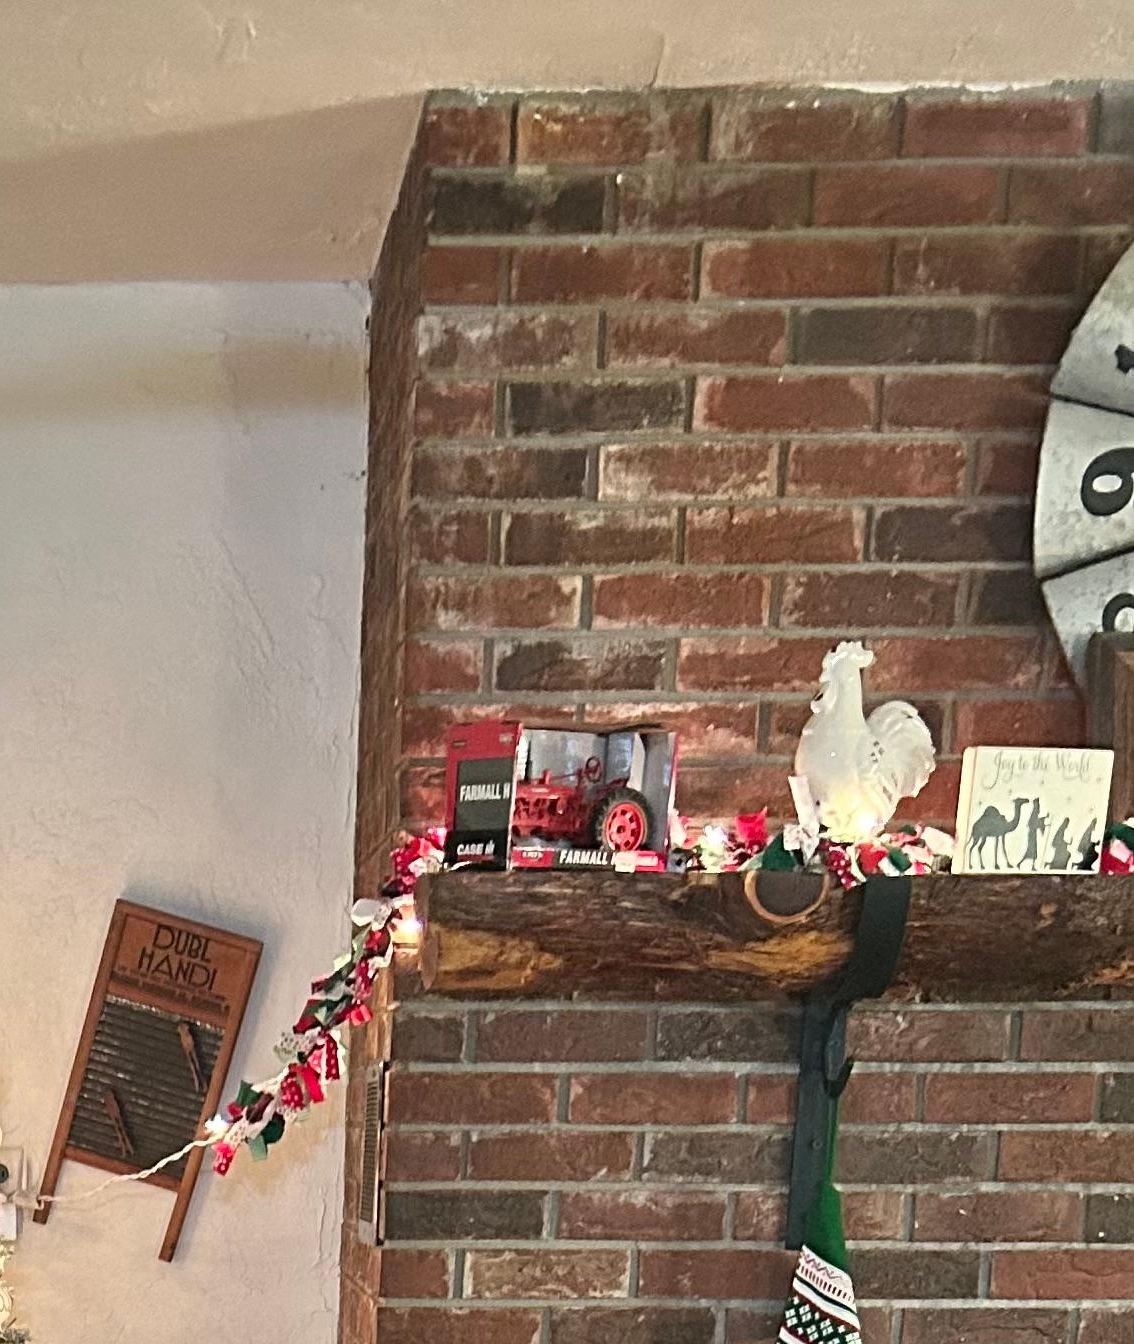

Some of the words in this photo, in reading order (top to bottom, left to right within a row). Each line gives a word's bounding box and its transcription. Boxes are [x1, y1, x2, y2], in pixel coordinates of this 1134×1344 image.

[982, 751, 1015, 790] Joy
[1017, 755, 1028, 771] to
[1031, 751, 1049, 771] the
[1056, 751, 1092, 782] World
[460, 784, 502, 802] FARMALL
[503, 783, 510, 799] H
[457, 844, 483, 856] CASE
[559, 849, 609, 866] FARMALL
[153, 924, 211, 963] DUBL
[138, 946, 217, 991] HANDI
